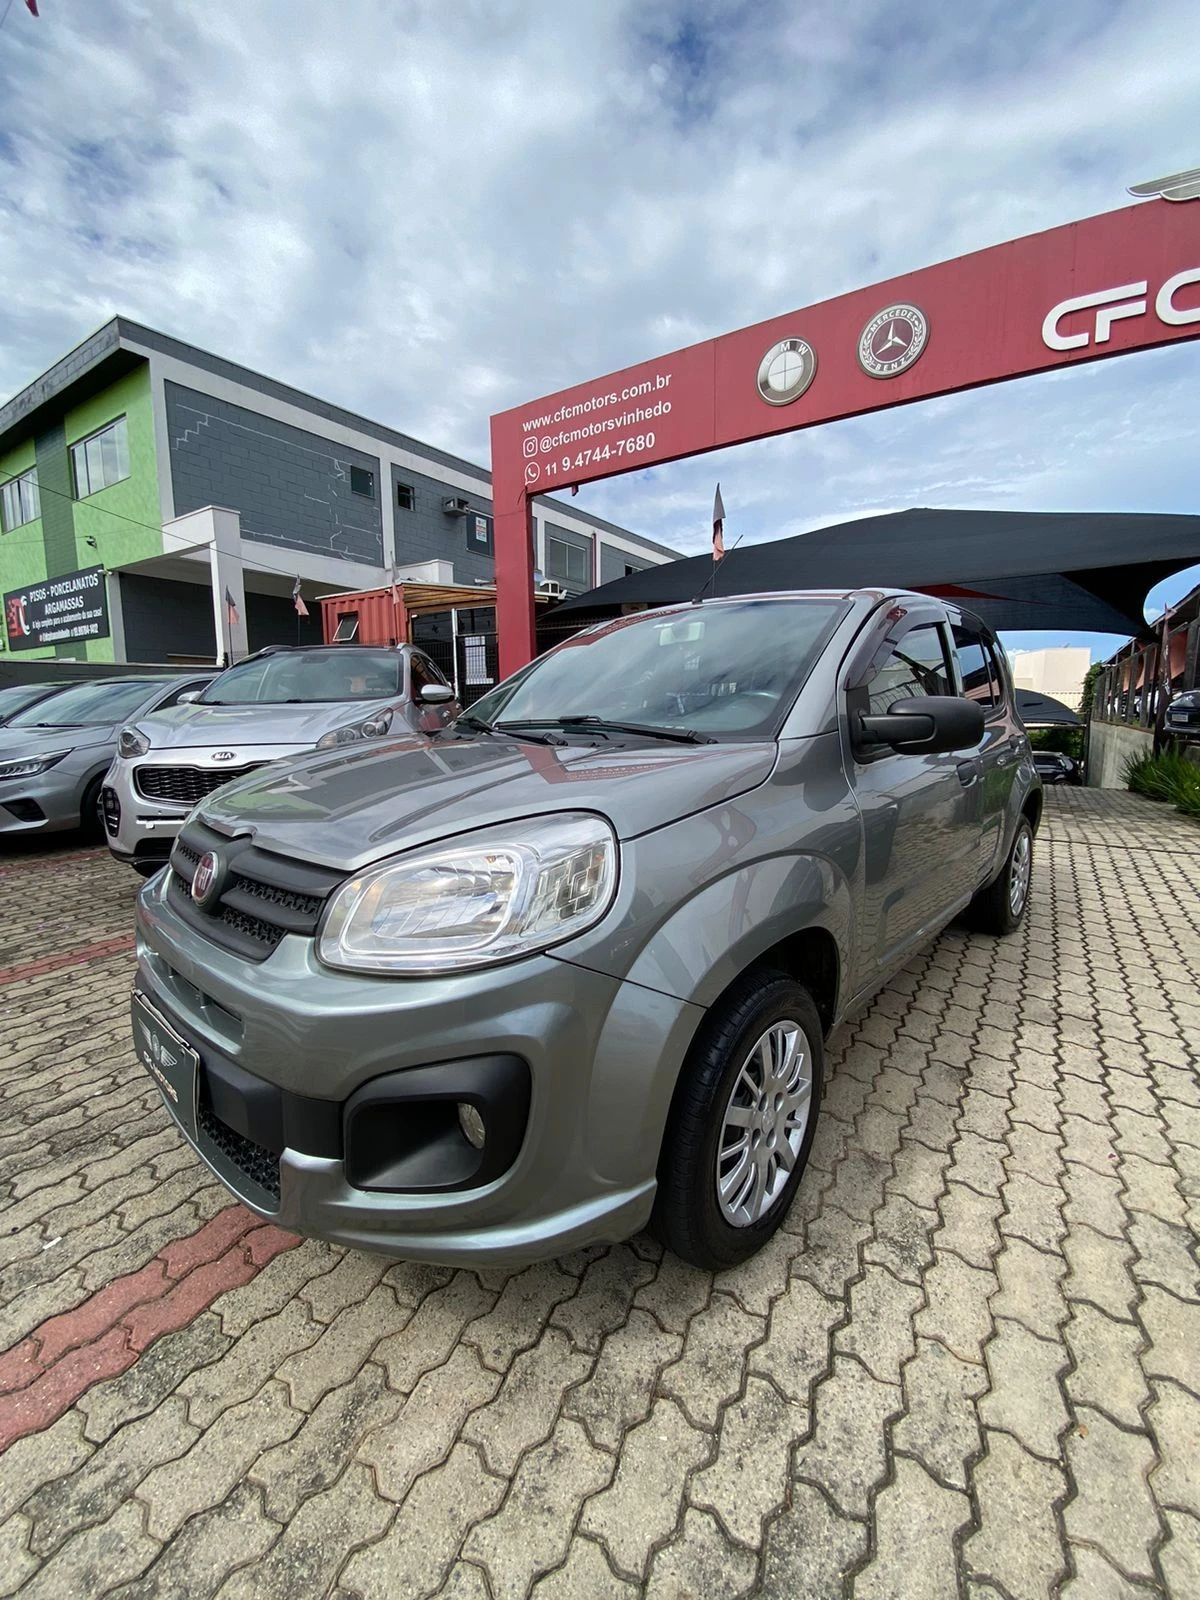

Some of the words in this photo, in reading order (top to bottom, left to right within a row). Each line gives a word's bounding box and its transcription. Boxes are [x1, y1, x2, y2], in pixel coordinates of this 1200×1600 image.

[870, 309, 917, 332] MERCEDES
[875, 358, 906, 372] BENZ
[522, 374, 672, 432] www.cfcmotors.com.br
[539, 401, 672, 453] @cfcmotorsvinhedo
[544, 462, 557, 476] 11
[562, 432, 655, 472] 9.4744-7680
[29, 588, 47, 603] PISOS
[50, 573, 99, 597] PORCELANATOS
[44, 595, 84, 615] ARGAMASSAS
[214, 752, 232, 760] KIA
